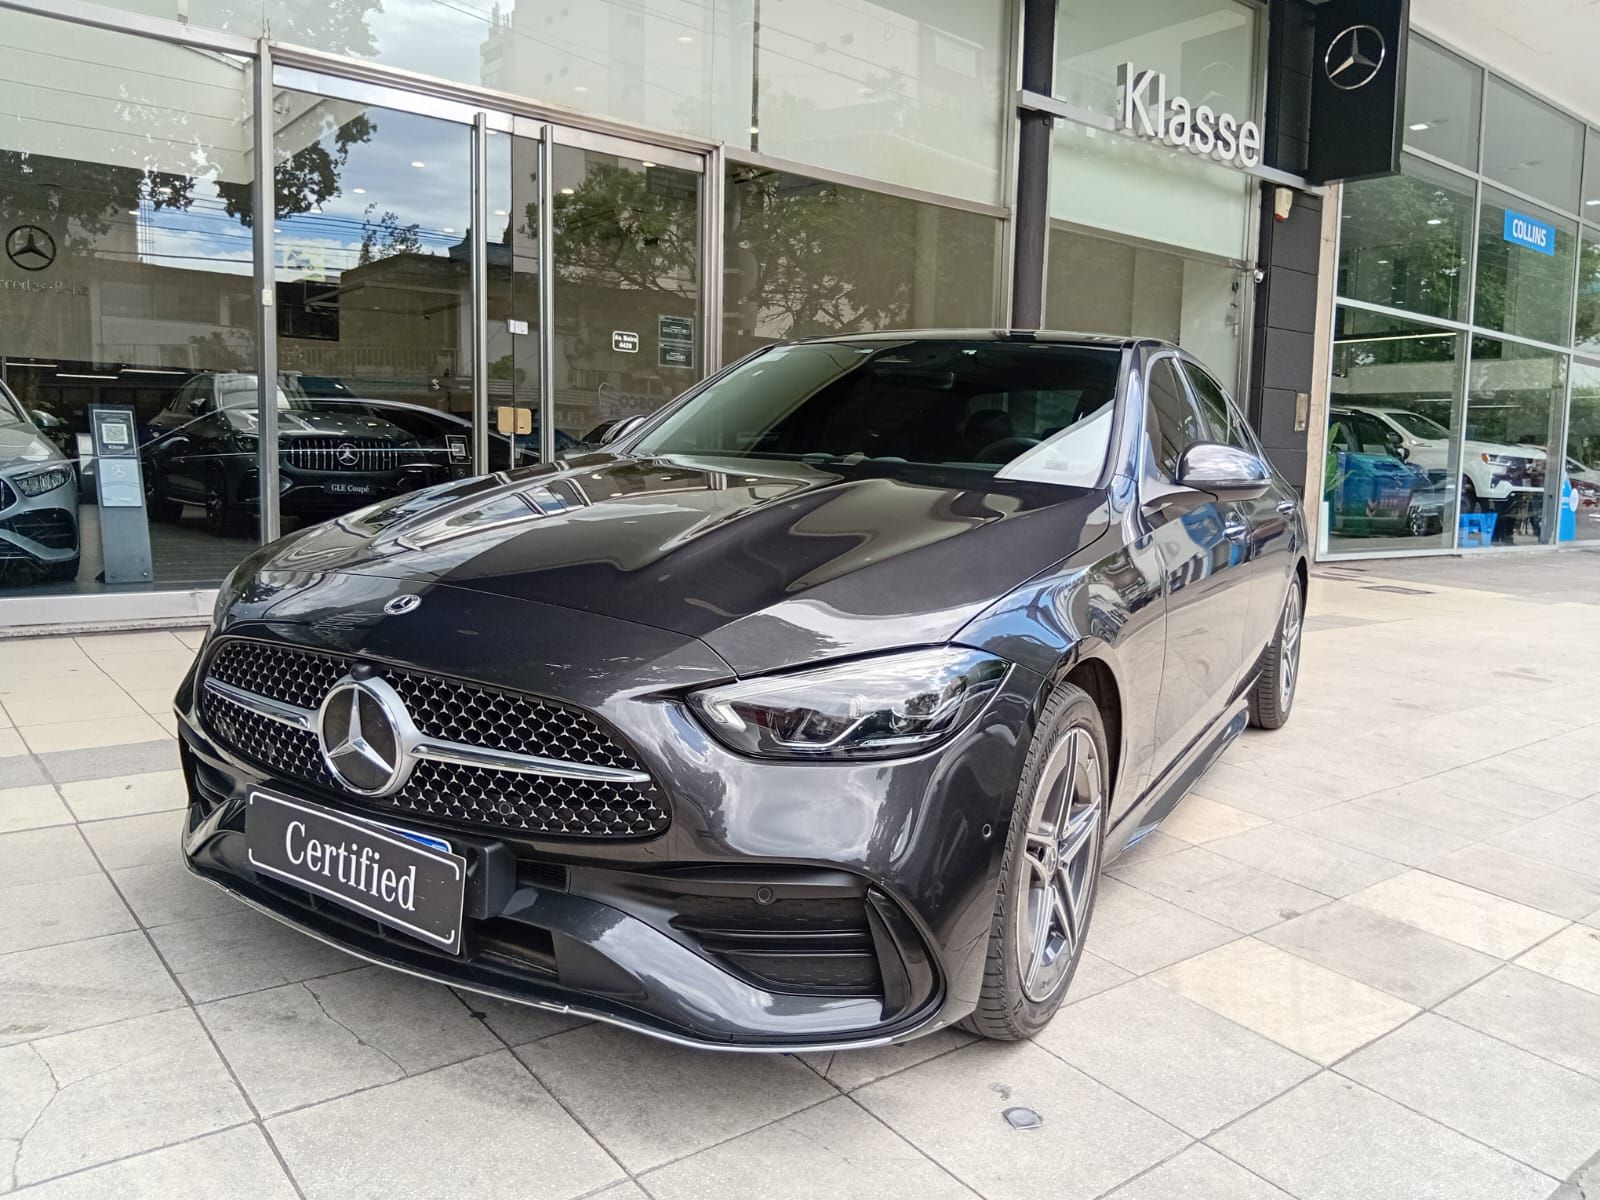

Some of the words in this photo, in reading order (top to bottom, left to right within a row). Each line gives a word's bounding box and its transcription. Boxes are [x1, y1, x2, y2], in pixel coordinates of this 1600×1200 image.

[1123, 61, 1260, 168] Klasse
[1512, 218, 1547, 247] COLLINS
[347, 484, 370, 494] Coupé
[286, 821, 416, 911] Certified
